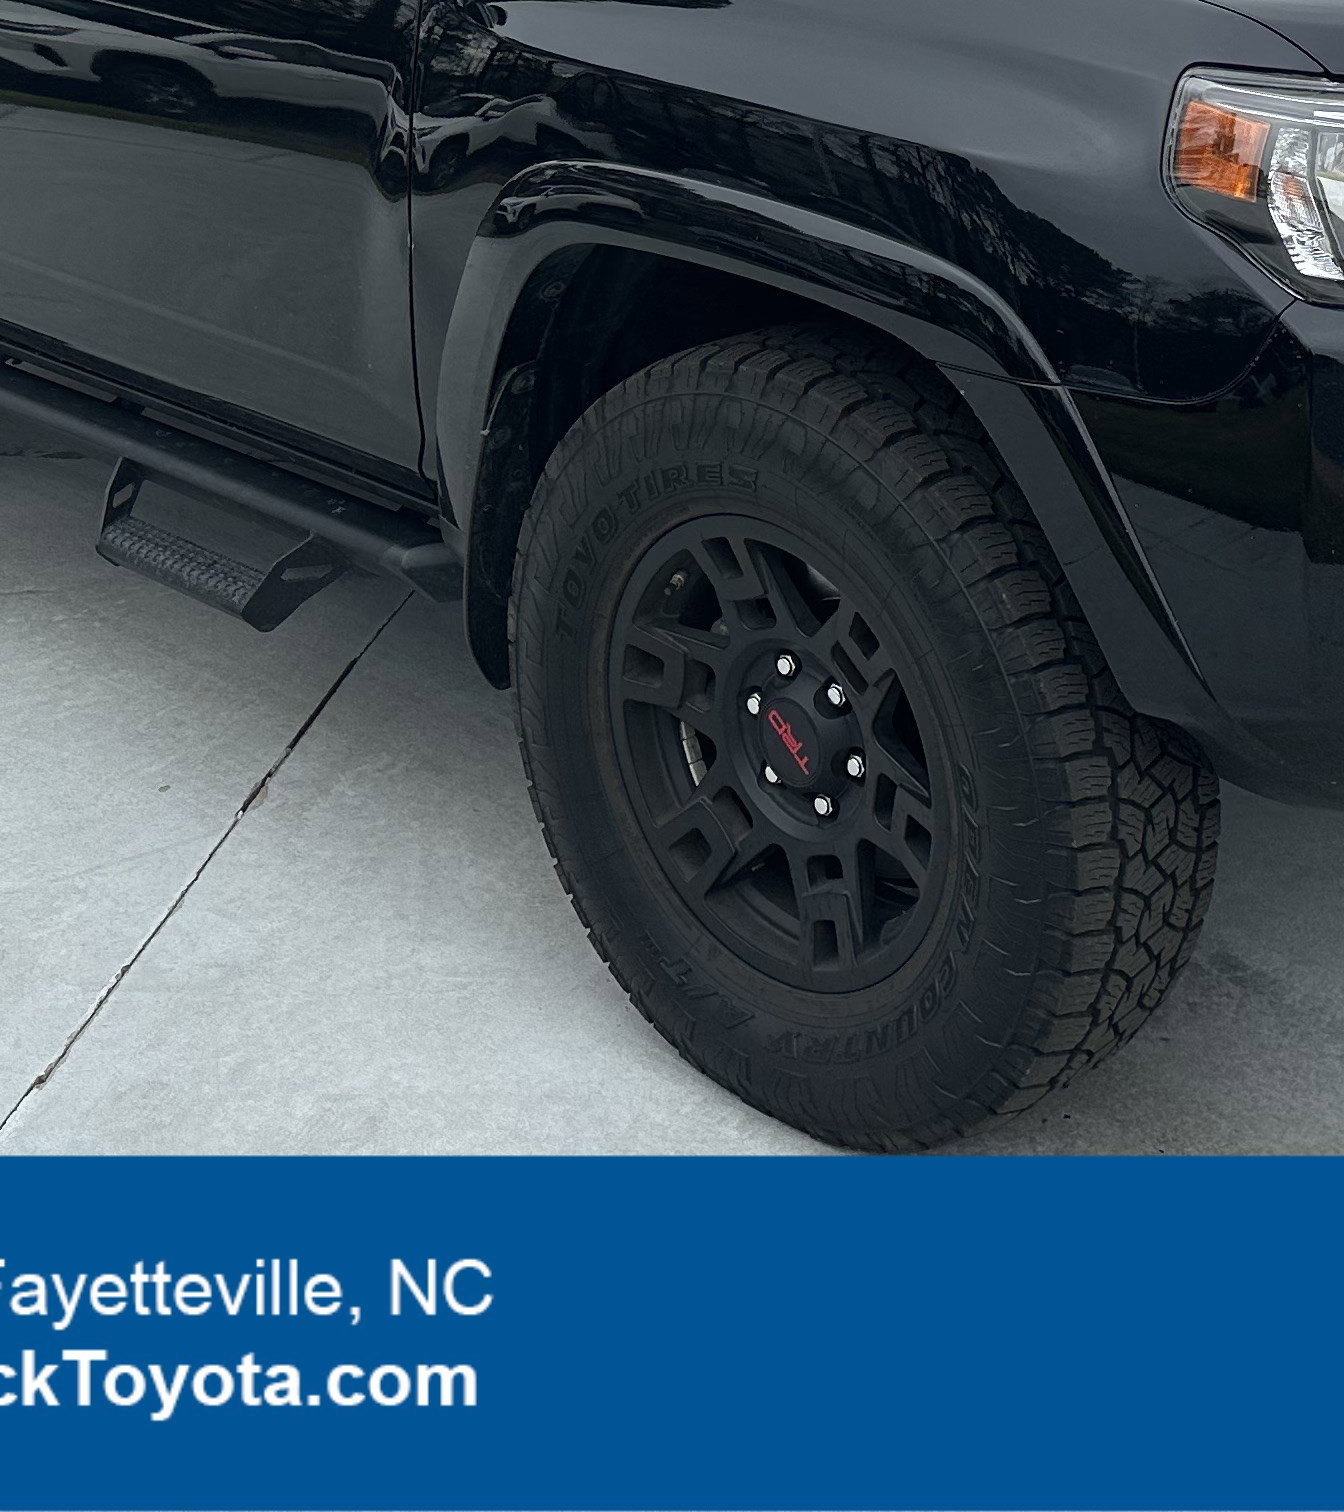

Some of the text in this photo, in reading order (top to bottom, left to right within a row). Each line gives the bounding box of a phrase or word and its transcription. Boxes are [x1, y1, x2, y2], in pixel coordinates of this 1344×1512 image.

[554, 461, 759, 641] TOYO TIRES
[767, 708, 810, 776] TRD
